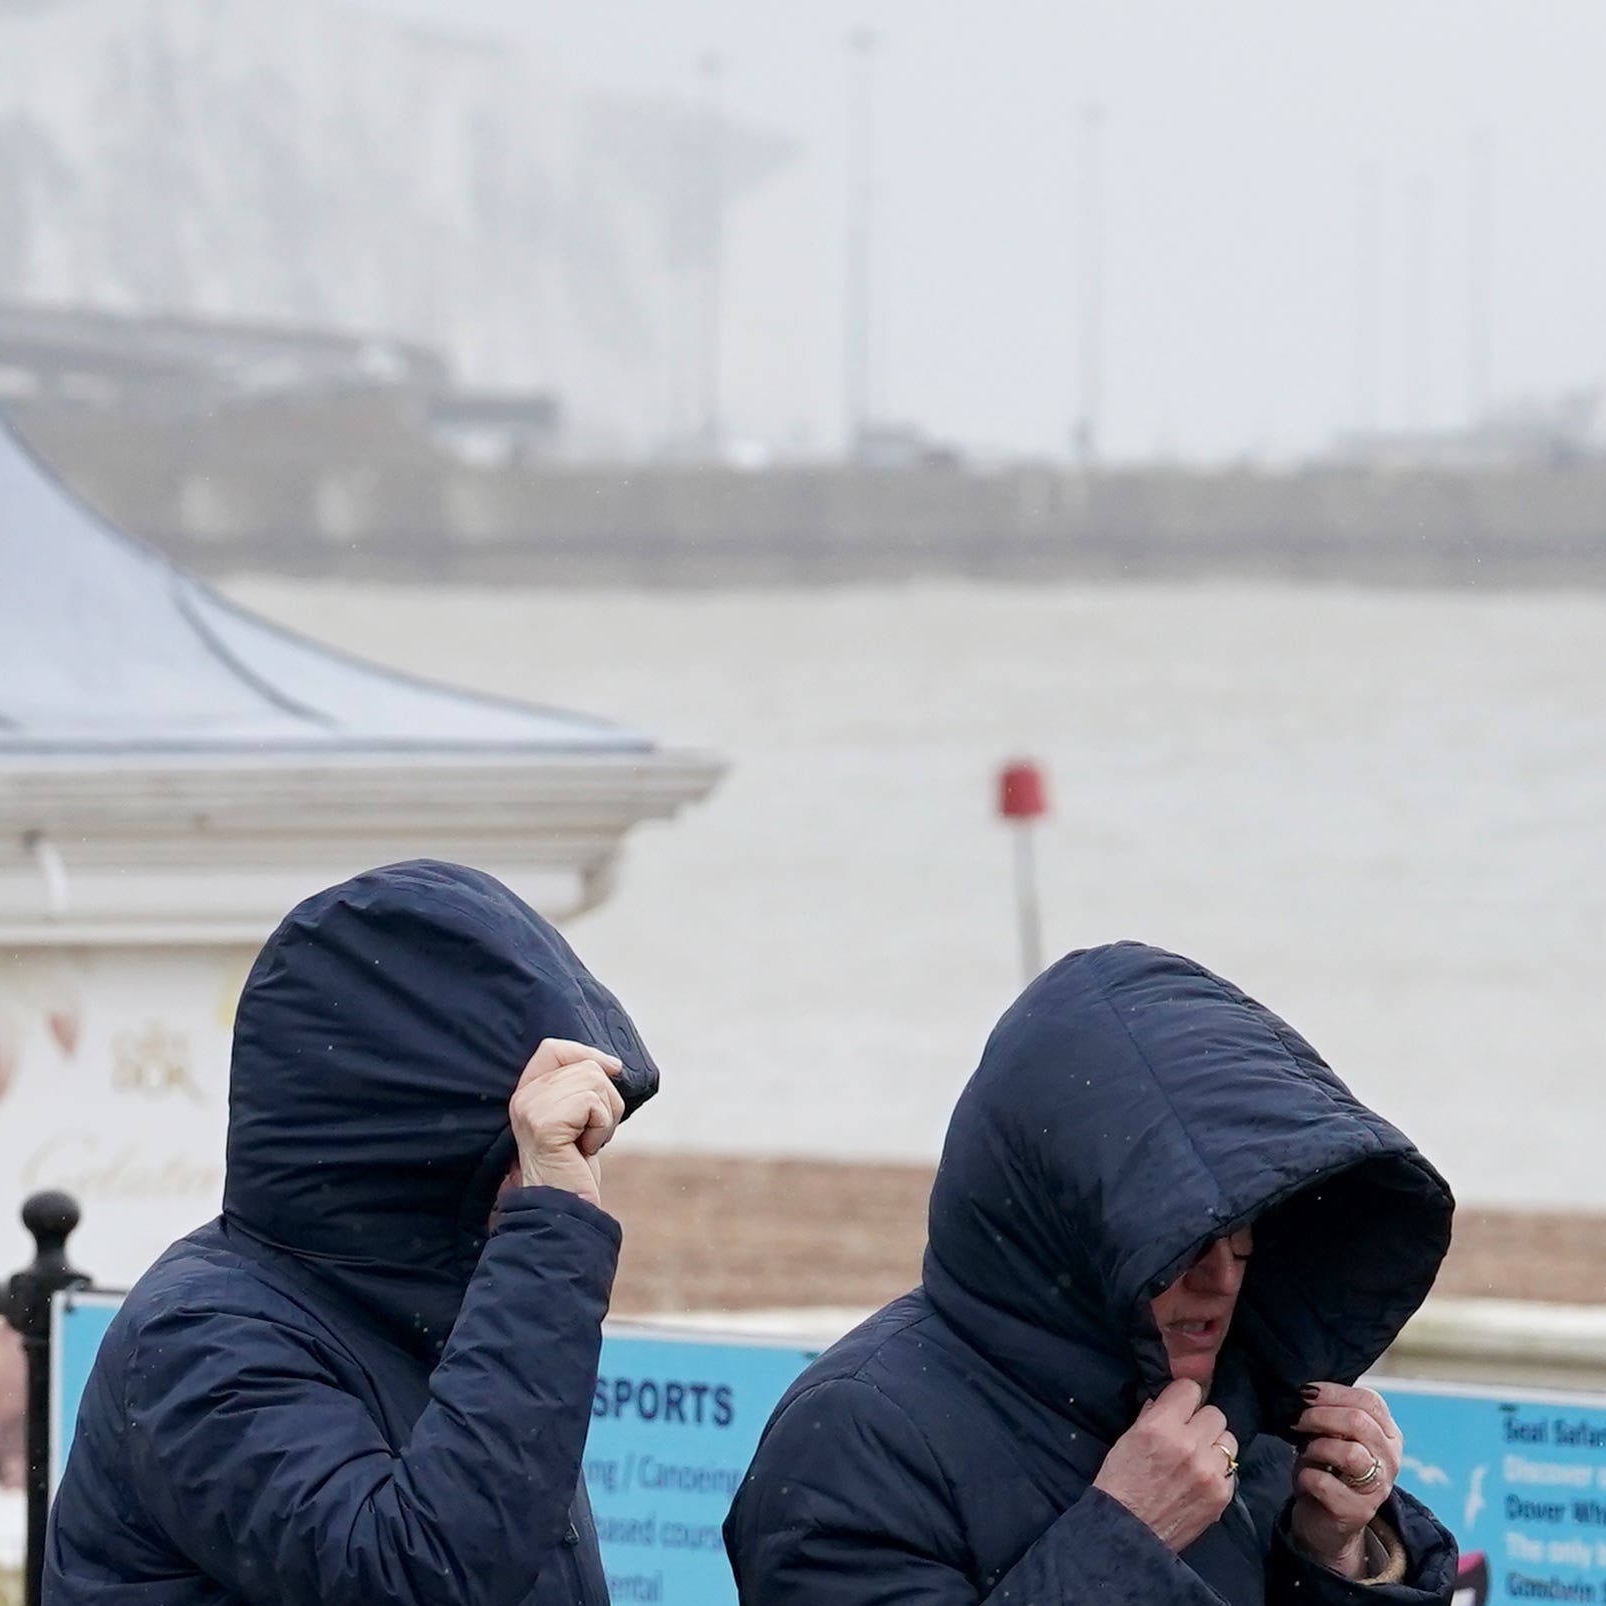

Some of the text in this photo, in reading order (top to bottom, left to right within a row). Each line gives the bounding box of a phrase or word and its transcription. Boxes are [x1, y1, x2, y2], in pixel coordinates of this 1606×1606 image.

[594, 1377, 734, 1427] SPORTS
[1504, 1416, 1545, 1446] Seal
[1504, 1454, 1592, 1485] Discover
[1505, 1494, 1565, 1522] Dover
[1506, 1532, 1542, 1562] The
[1548, 1540, 1591, 1570] only
[1506, 1572, 1592, 1602] Goodwin
